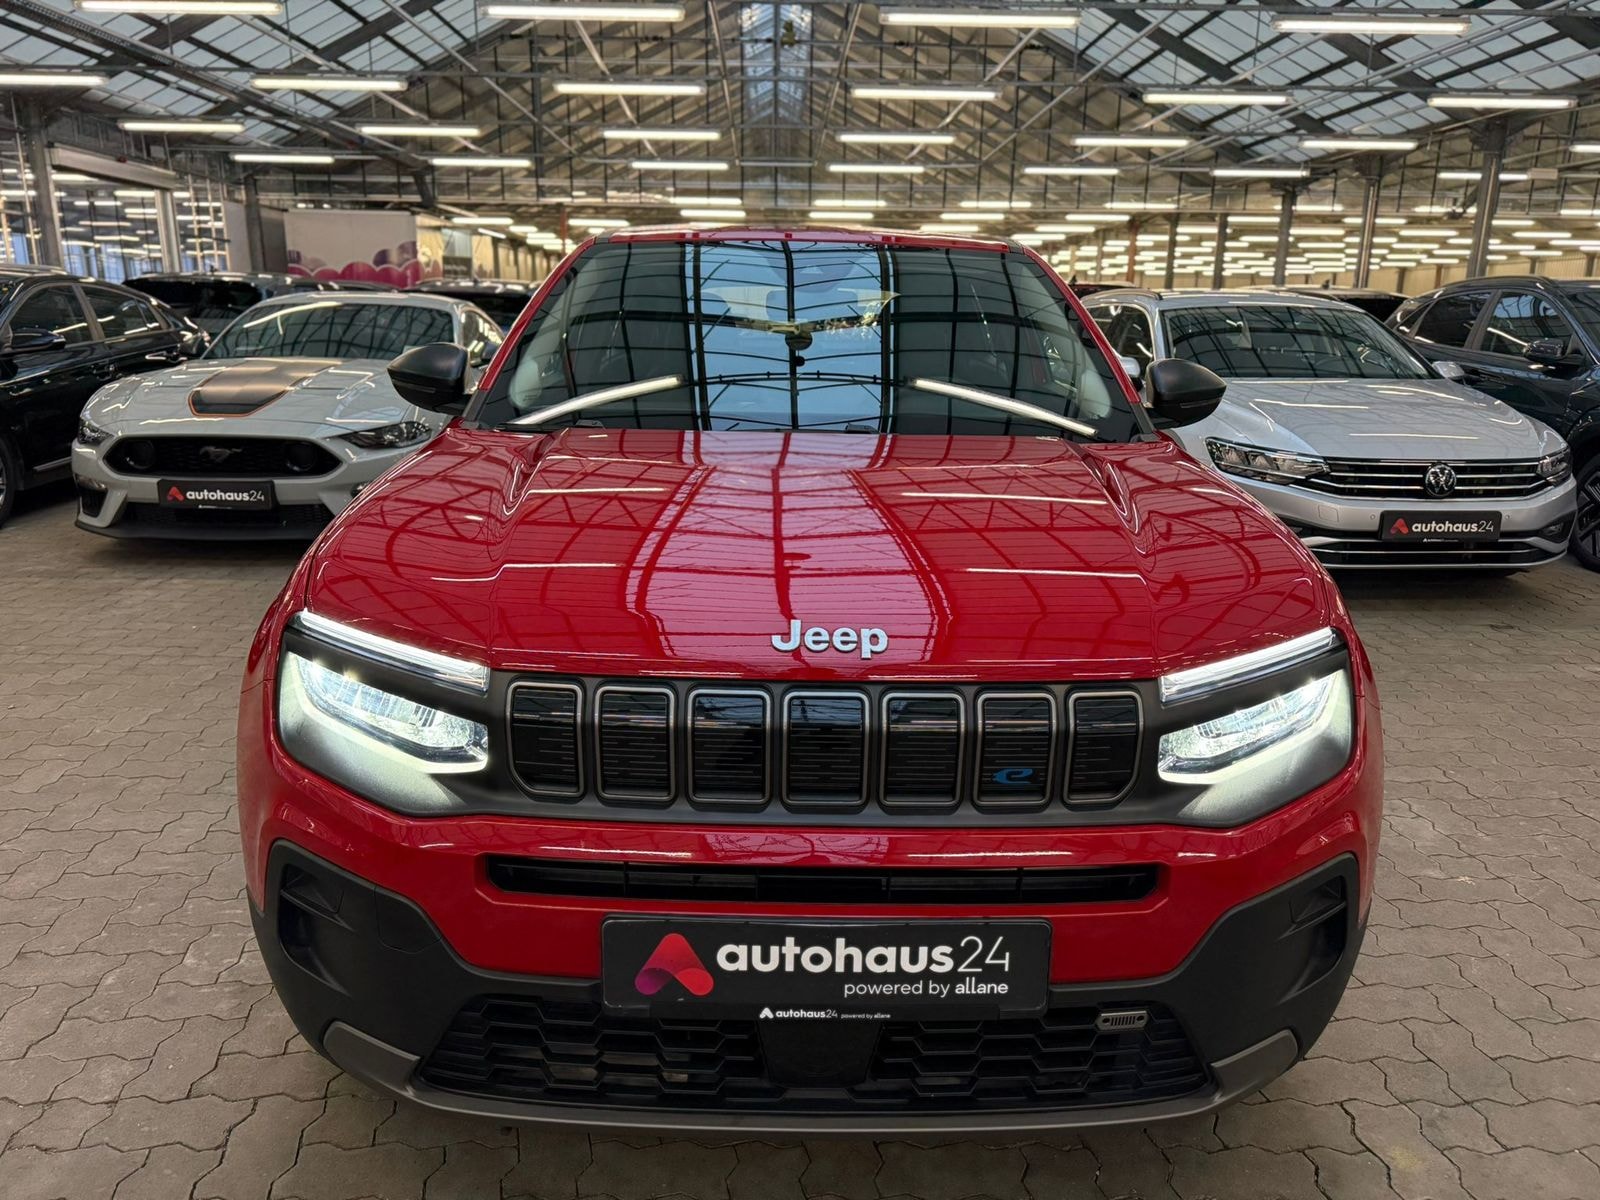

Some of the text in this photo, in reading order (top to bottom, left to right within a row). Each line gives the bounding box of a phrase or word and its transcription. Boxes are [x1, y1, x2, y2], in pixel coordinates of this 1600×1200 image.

[186, 489, 265, 502] autohaus24
[1411, 520, 1494, 533] autohaus24
[771, 619, 889, 660] Jeep
[716, 935, 1010, 974] autohaus24
[844, 976, 1009, 998] powered by allane
[775, 1008, 838, 1019] autohaus24
